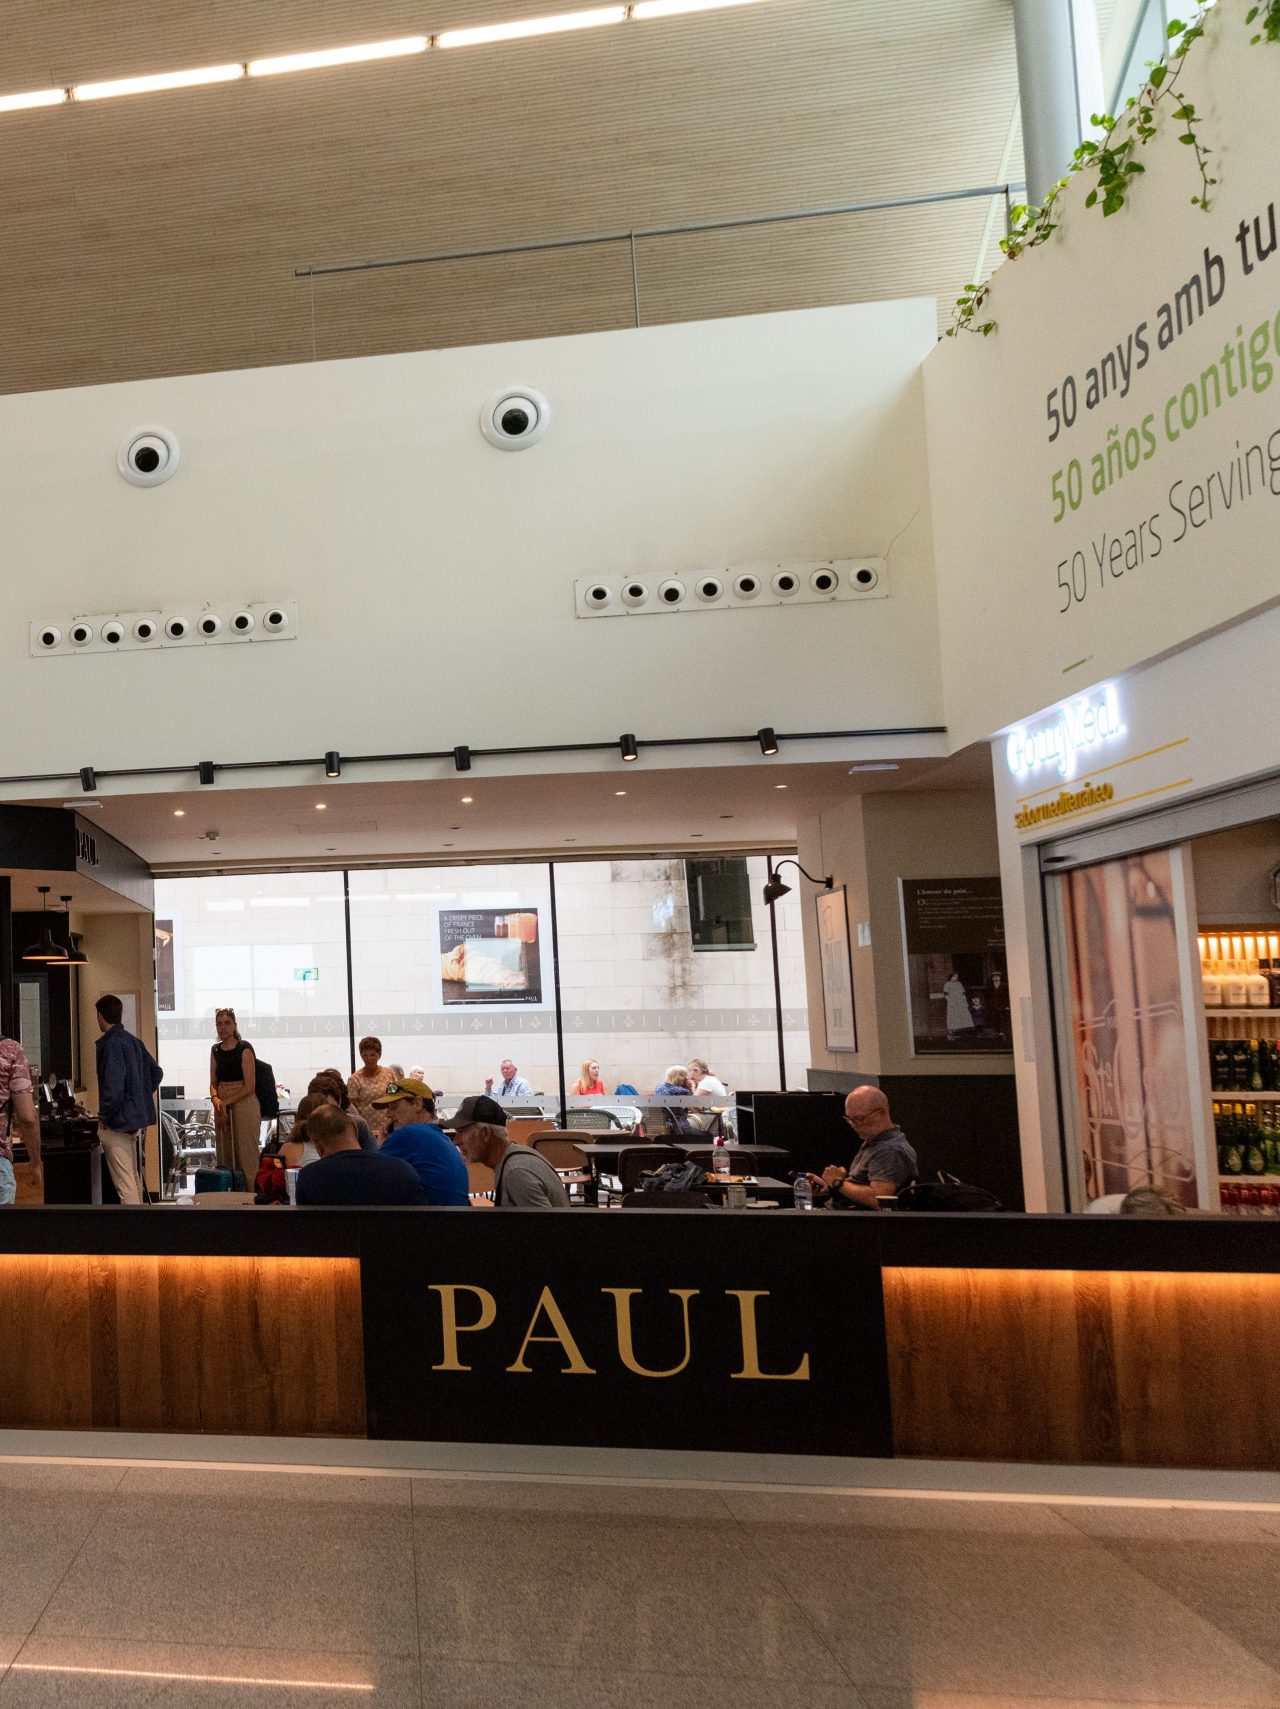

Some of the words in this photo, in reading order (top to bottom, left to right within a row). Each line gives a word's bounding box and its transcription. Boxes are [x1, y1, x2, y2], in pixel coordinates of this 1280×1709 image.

[1047, 375, 1077, 443] 50
[1085, 321, 1150, 410] anys
[1157, 246, 1225, 350] amb
[1235, 202, 1277, 275] tu
[1051, 458, 1083, 524] 50
[1091, 413, 1156, 496] años
[1058, 551, 1087, 614] 50
[1092, 513, 1162, 588] Years
[428, 1284, 811, 1381] PAUL
